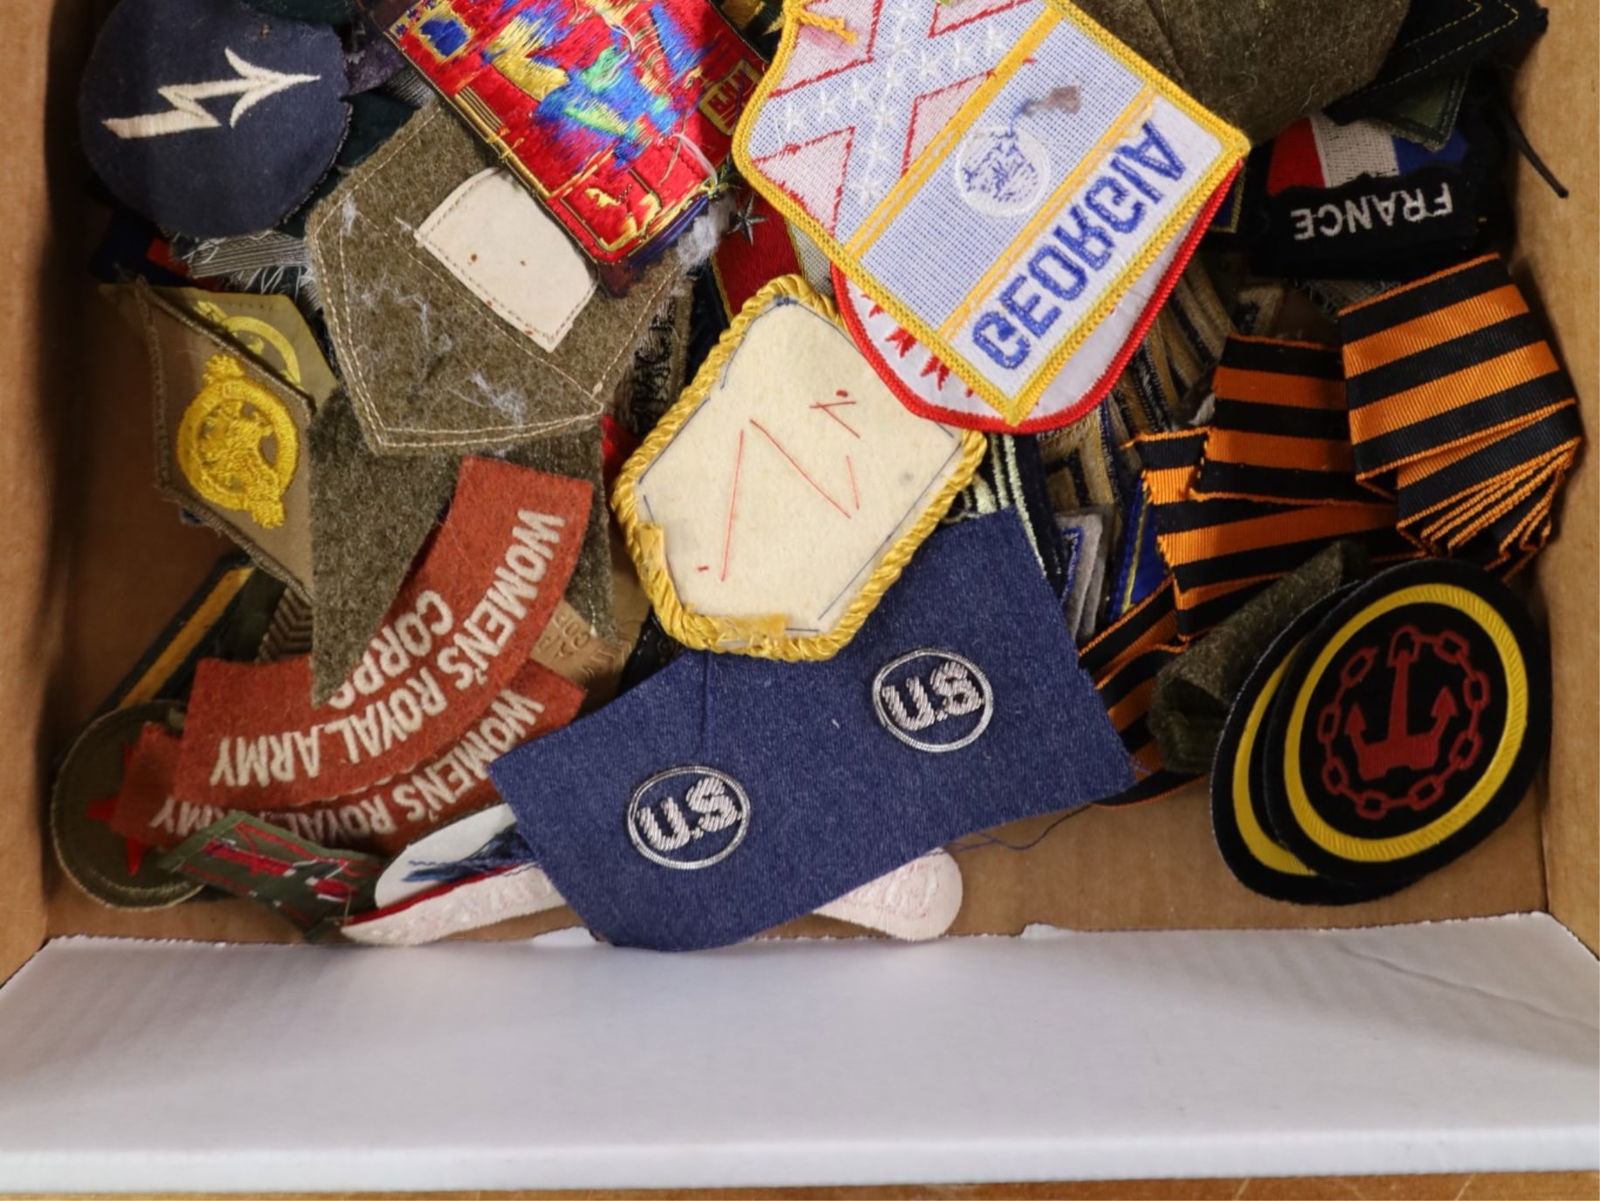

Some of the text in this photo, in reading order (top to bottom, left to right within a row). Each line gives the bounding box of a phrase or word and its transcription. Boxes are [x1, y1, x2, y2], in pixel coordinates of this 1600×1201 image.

[1291, 182, 1453, 239] FRANCE
[320, 669, 447, 763] ROYAL
[212, 727, 327, 784] ARMY
